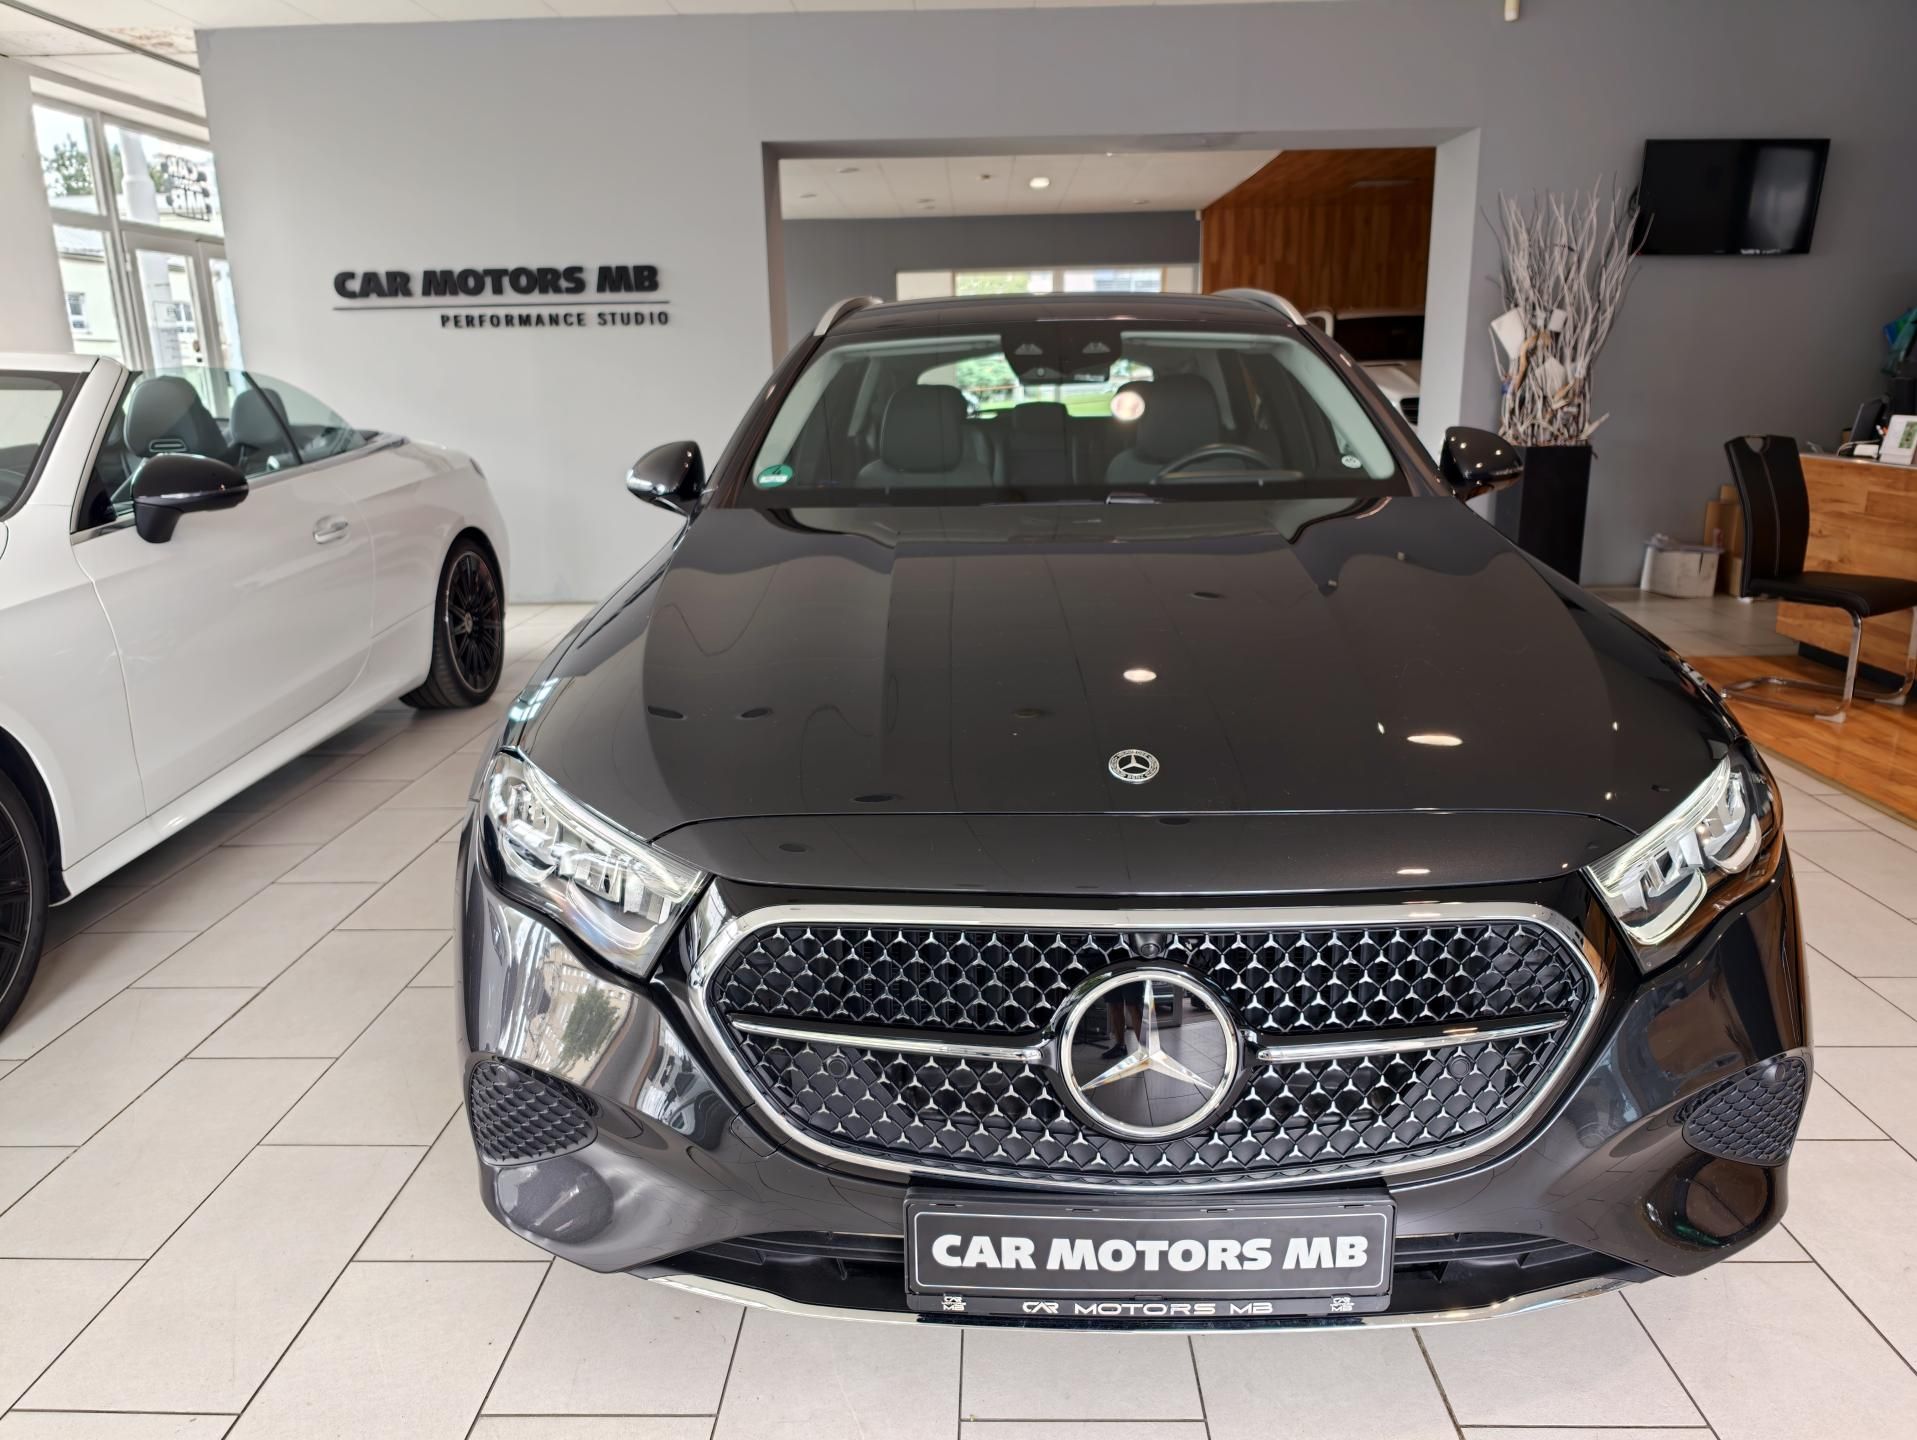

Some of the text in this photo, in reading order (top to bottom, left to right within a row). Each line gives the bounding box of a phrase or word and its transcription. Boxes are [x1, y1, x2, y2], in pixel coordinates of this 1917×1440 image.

[333, 265, 659, 299] CAR MOTORS MB
[440, 311, 669, 328] PERFORMANCE STUDIO
[931, 1234, 1368, 1271] CAR MOTORS MB
[1022, 1302, 1273, 1315] CAR MOTORS MB
